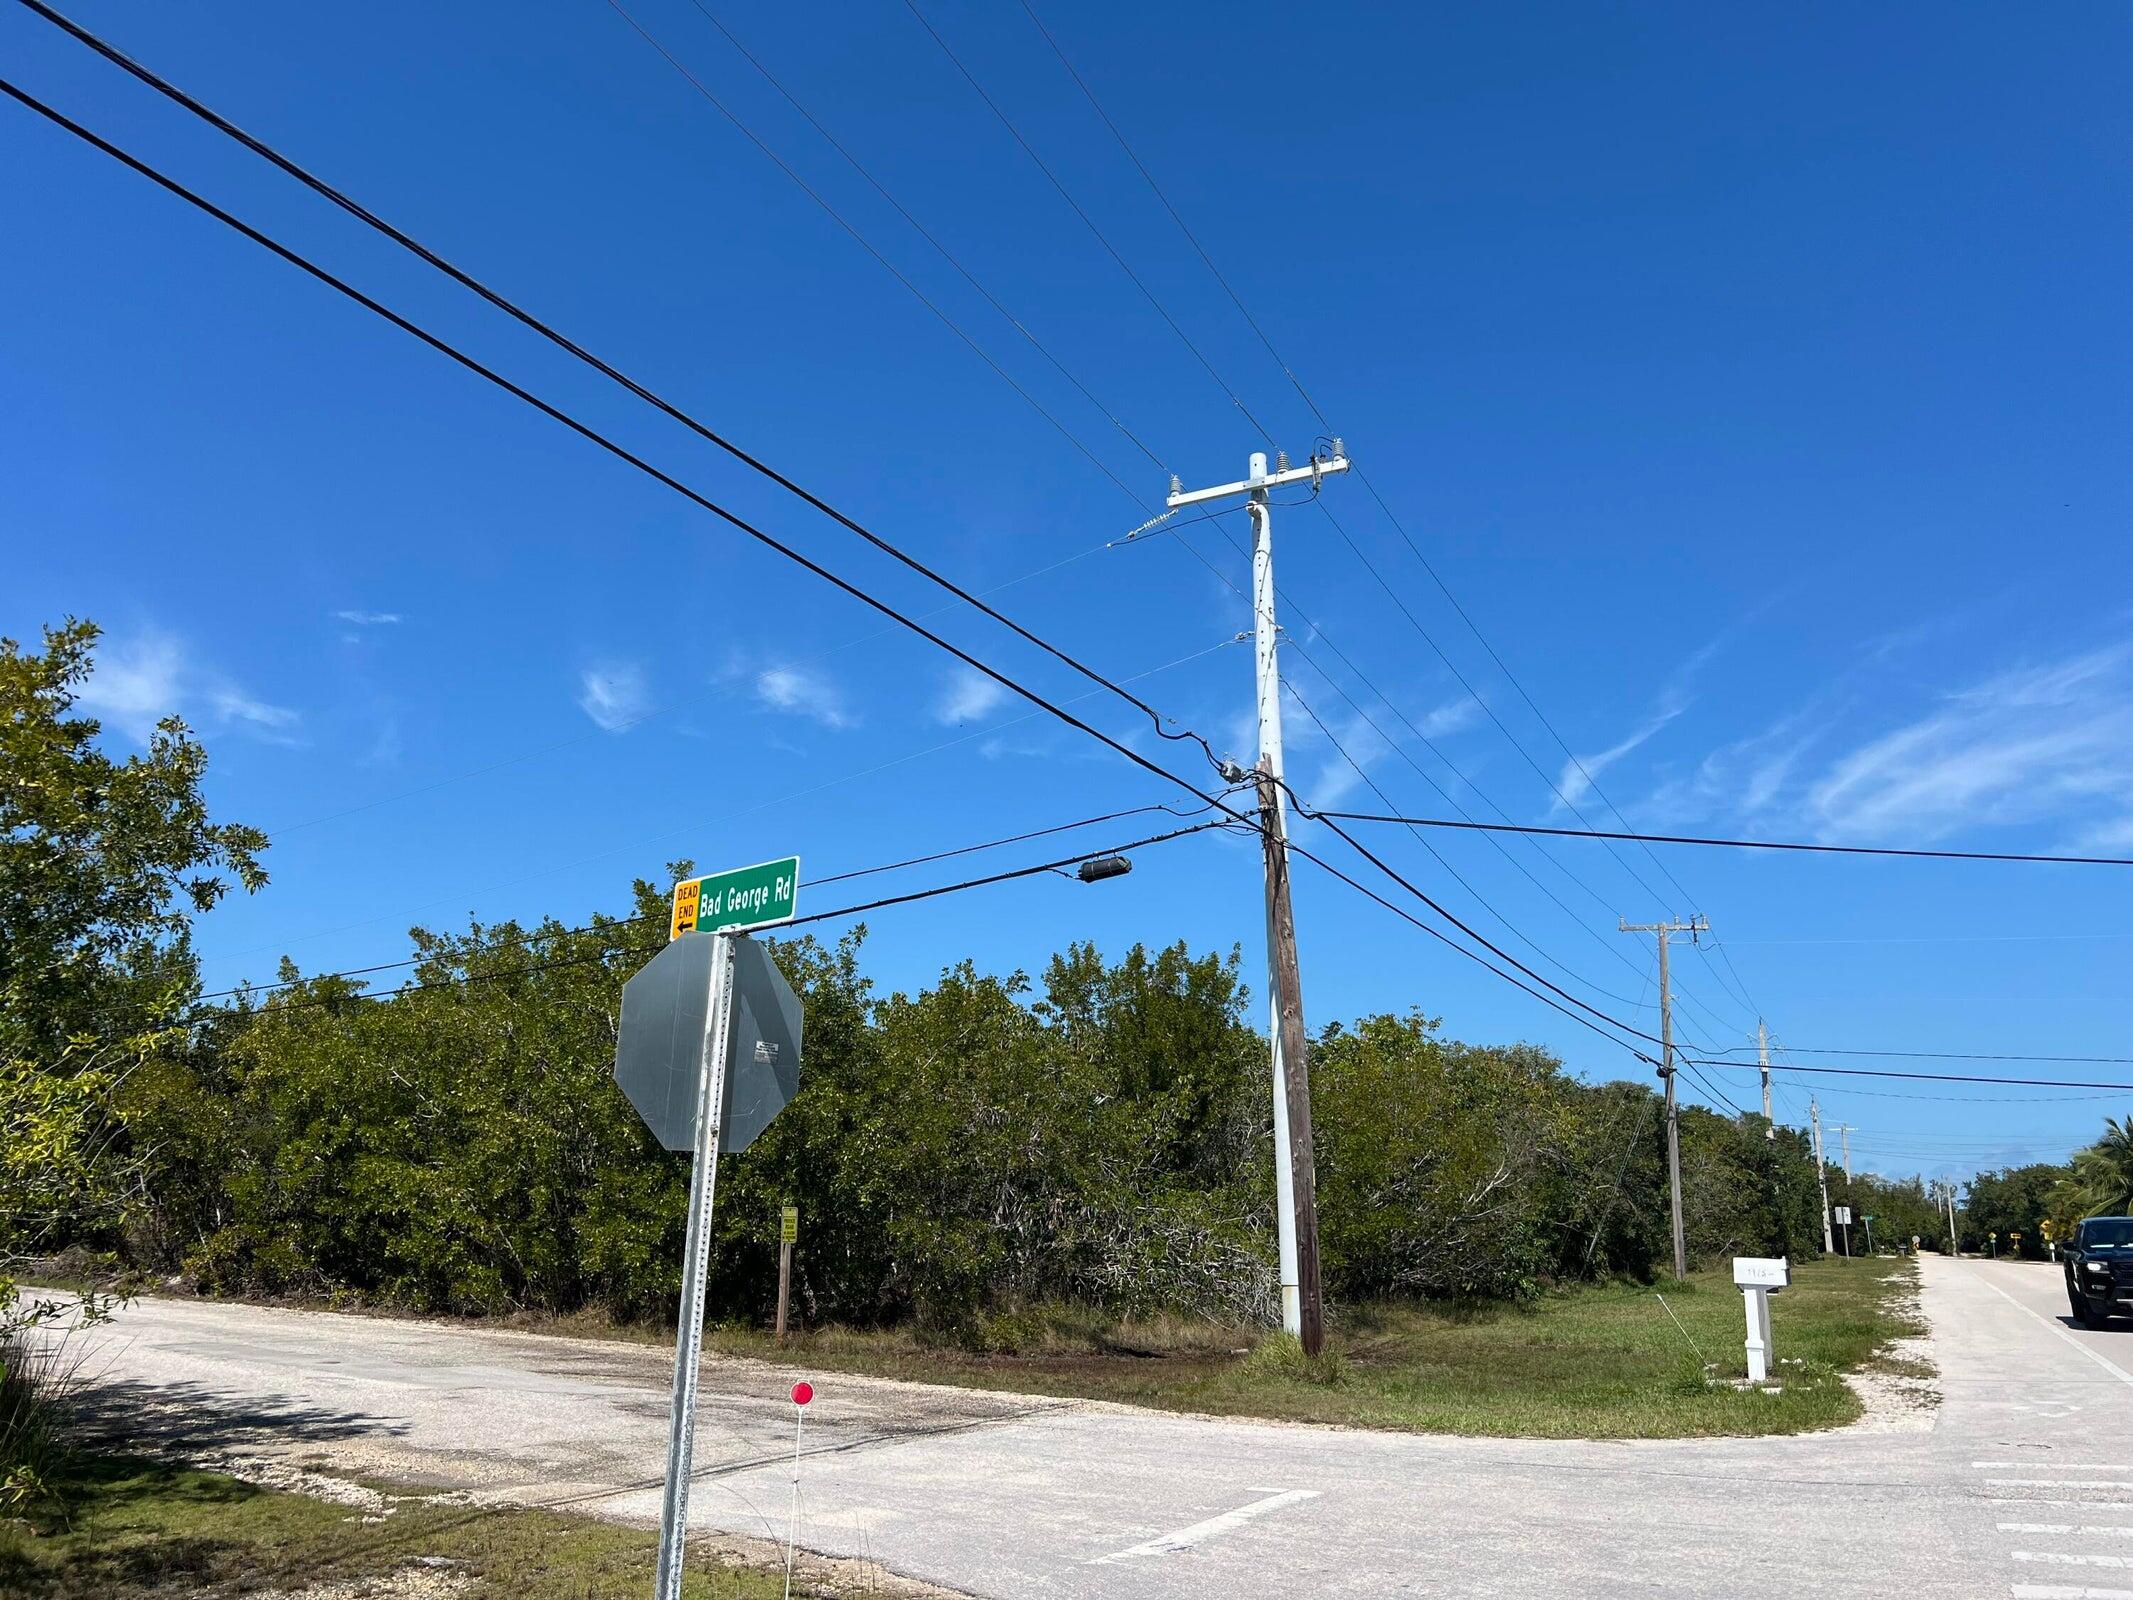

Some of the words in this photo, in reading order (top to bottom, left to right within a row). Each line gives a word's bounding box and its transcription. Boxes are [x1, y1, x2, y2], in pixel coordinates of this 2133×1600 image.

[678, 885, 698, 901] DEAD
[699, 890, 722, 918] Bad
[727, 885, 769, 915] George
[774, 874, 791, 902] Rd
[679, 904, 694, 919] END
